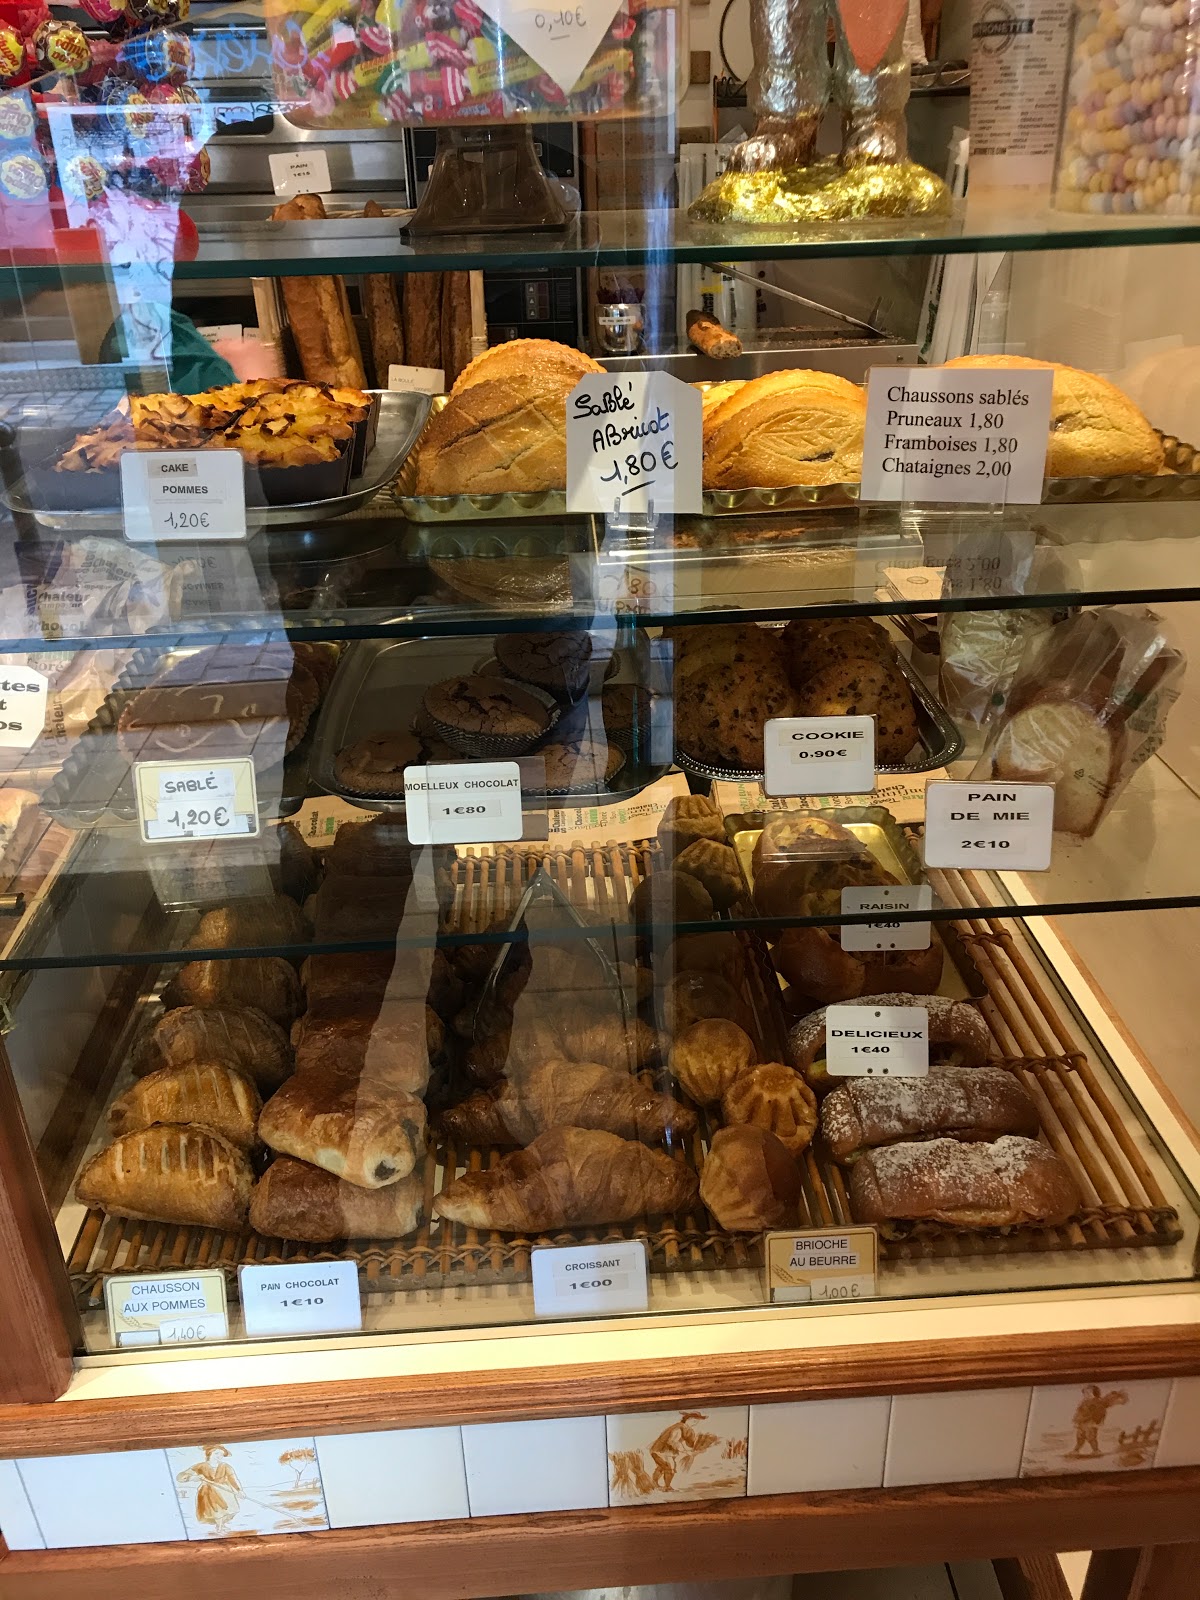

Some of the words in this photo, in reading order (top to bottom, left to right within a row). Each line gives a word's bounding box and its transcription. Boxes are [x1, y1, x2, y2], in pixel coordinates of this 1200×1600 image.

[887, 386, 974, 405] Chaussons
[979, 389, 1029, 406] sablés
[886, 410, 963, 428] Pruneaux
[969, 412, 1004, 431] 1,80
[884, 434, 977, 453] Framboises
[983, 437, 1018, 456] 1,80
[161, 463, 189, 473] CAKE
[882, 457, 971, 478] Chataignes
[976, 460, 1012, 478] 2,00
[162, 485, 208, 494] POMMES
[164, 511, 210, 529] 1,20€
[792, 731, 865, 740] COOKIE
[799, 749, 847, 759] 0,90€
[164, 771, 219, 793] SABLÉ
[405, 781, 459, 791] MOELLEUX
[464, 779, 519, 789] CHOCOLAT
[968, 793, 1017, 802] PAIN
[442, 805, 486, 815] 1€80
[950, 812, 980, 820] DE
[993, 812, 1030, 820] MIE
[167, 806, 230, 829] 1,20€
[961, 840, 1010, 849] 2€10
[831, 1030, 923, 1039] DELICIEUX
[851, 1046, 890, 1054] 1€40
[795, 1239, 848, 1250] BRIOCHE
[565, 1259, 621, 1271] CROISSANT
[789, 1257, 806, 1267] AU
[809, 1255, 857, 1266] BEURRE
[131, 1281, 200, 1296] CHAUSSON
[260, 1283, 281, 1291] PAIN
[285, 1278, 340, 1289] CHOCOLAT
[569, 1279, 613, 1290] 1€00
[819, 1283, 861, 1299] 1,00€
[123, 1302, 149, 1313] AUX
[152, 1298, 206, 1311] POMMES
[280, 1297, 324, 1307] 1€10
[167, 1324, 207, 1341] 1,40€
